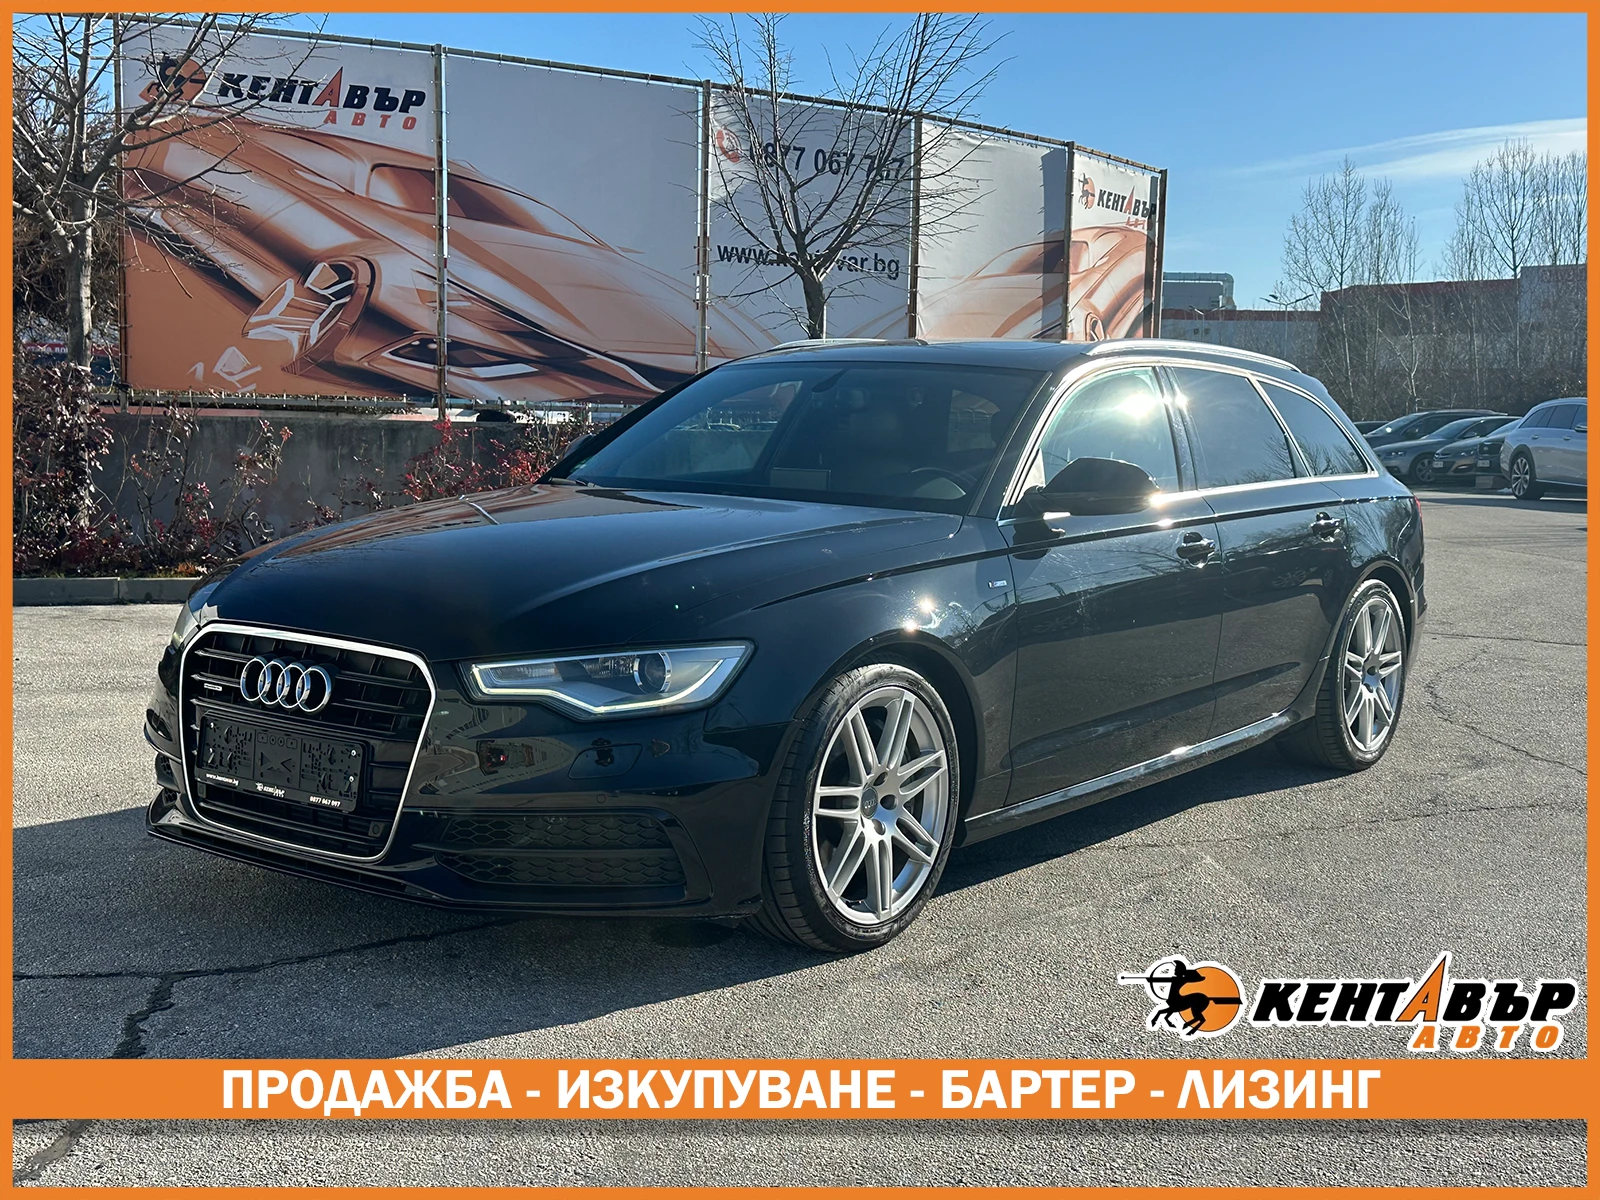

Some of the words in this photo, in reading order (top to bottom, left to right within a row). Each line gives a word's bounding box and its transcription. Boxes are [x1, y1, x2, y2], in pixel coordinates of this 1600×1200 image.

[218, 66, 427, 114] КЕНТАВЪР
[323, 110, 417, 130] АВТО
[750, 142, 806, 171] 877
[814, 148, 856, 176] 067
[864, 155, 905, 180] 77
[1097, 186, 1156, 219] КЕНТАВЪР
